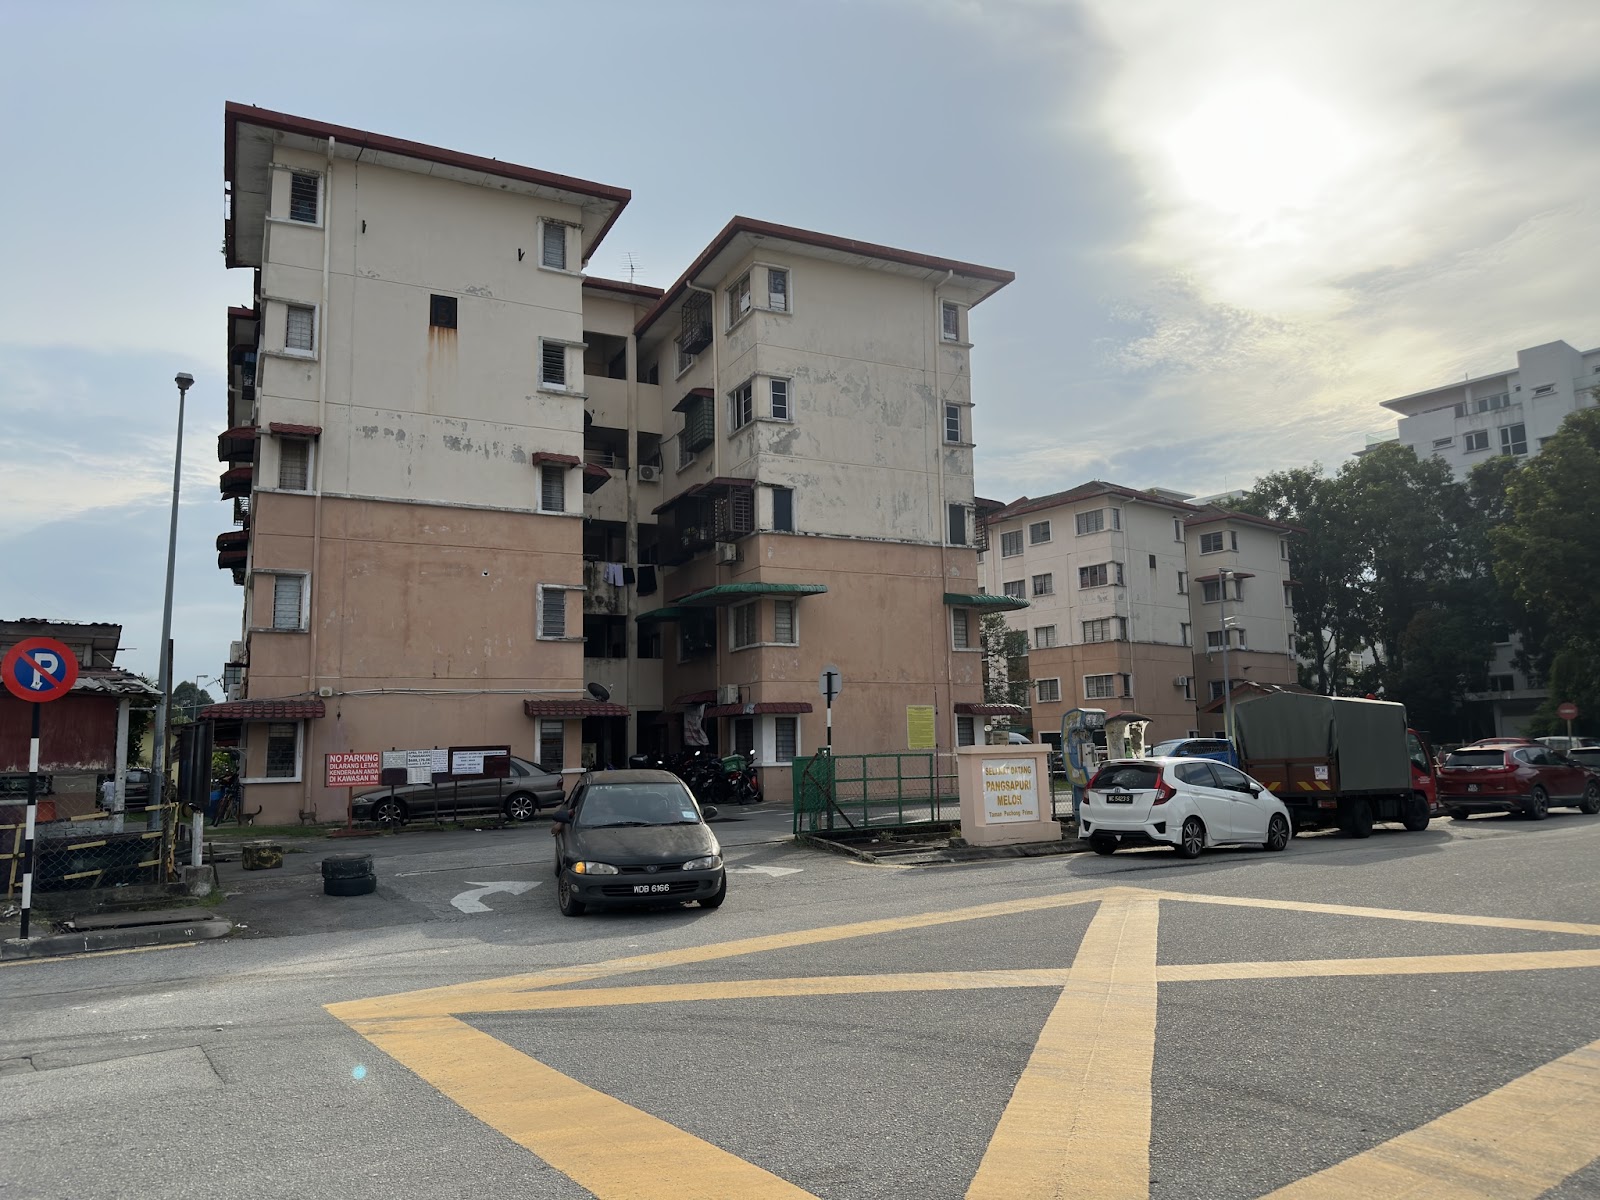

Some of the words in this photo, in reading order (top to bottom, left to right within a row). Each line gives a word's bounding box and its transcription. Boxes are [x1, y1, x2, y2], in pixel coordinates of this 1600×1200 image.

[330, 754, 342, 763] NO
[343, 753, 379, 763] PARKING
[1010, 766, 1031, 775] DATANG
[337, 774, 369, 782] KAWASAN
[986, 780, 1031, 791] PANGSAPURI
[651, 883, 670, 893] 6166
